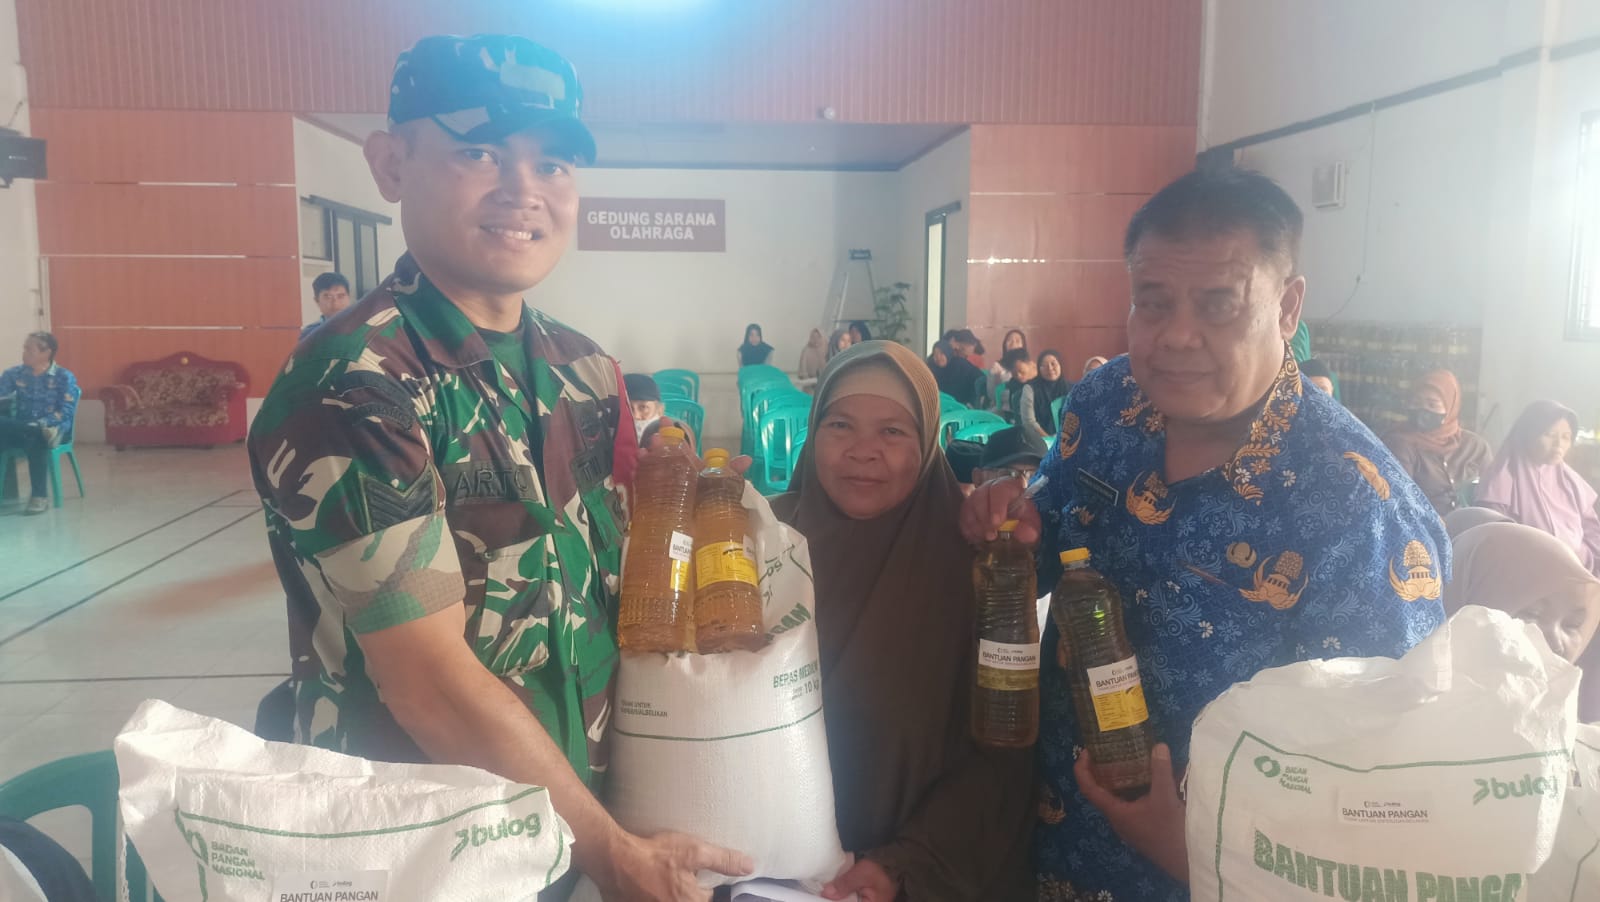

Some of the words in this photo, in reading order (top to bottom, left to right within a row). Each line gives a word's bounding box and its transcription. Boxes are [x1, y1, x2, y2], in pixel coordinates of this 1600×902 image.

[587, 211, 650, 226] GEDUNG
[654, 212, 716, 226] SARANA
[610, 226, 694, 240] OLAHRAGA
[1096, 674, 1127, 688] BANTUAN
[1342, 808, 1386, 818] BANTUAN
[1388, 810, 1428, 818] PANGAN
[471, 813, 541, 847] bulog
[211, 841, 248, 856] BADAN
[211, 853, 255, 868] PANGAN
[1254, 829, 1408, 902] BANTUAN
[1415, 872, 1522, 902] PANGA
[280, 892, 332, 902] BANTUAN
[335, 891, 378, 902] PANGAN
